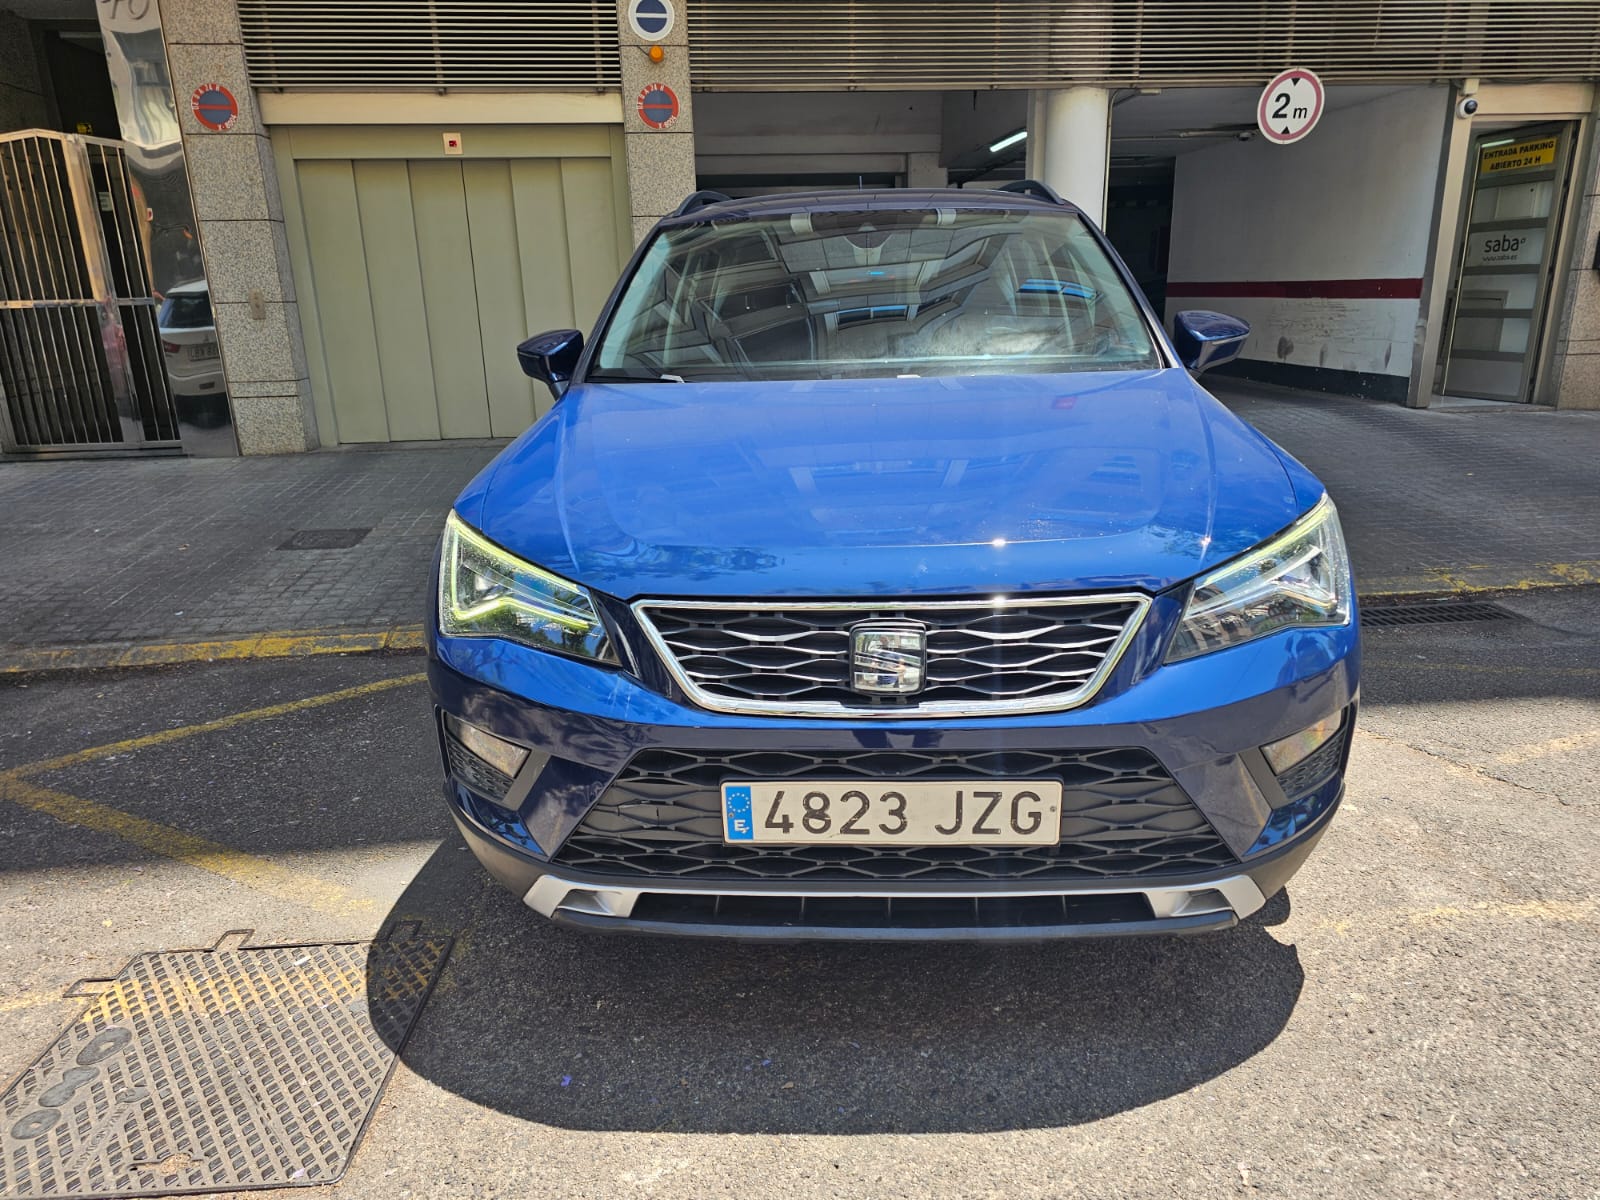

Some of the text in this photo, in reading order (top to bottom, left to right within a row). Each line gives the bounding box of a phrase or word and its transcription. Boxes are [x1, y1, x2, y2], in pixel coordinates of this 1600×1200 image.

[1272, 92, 1308, 119] 2 m
[1484, 140, 1554, 160] ENTRADA PARKING
[1490, 155, 1542, 171] ABIERTO 24 H
[1484, 234, 1520, 253] saba
[764, 790, 1042, 835] 4823 JZG
[734, 819, 746, 831] E
